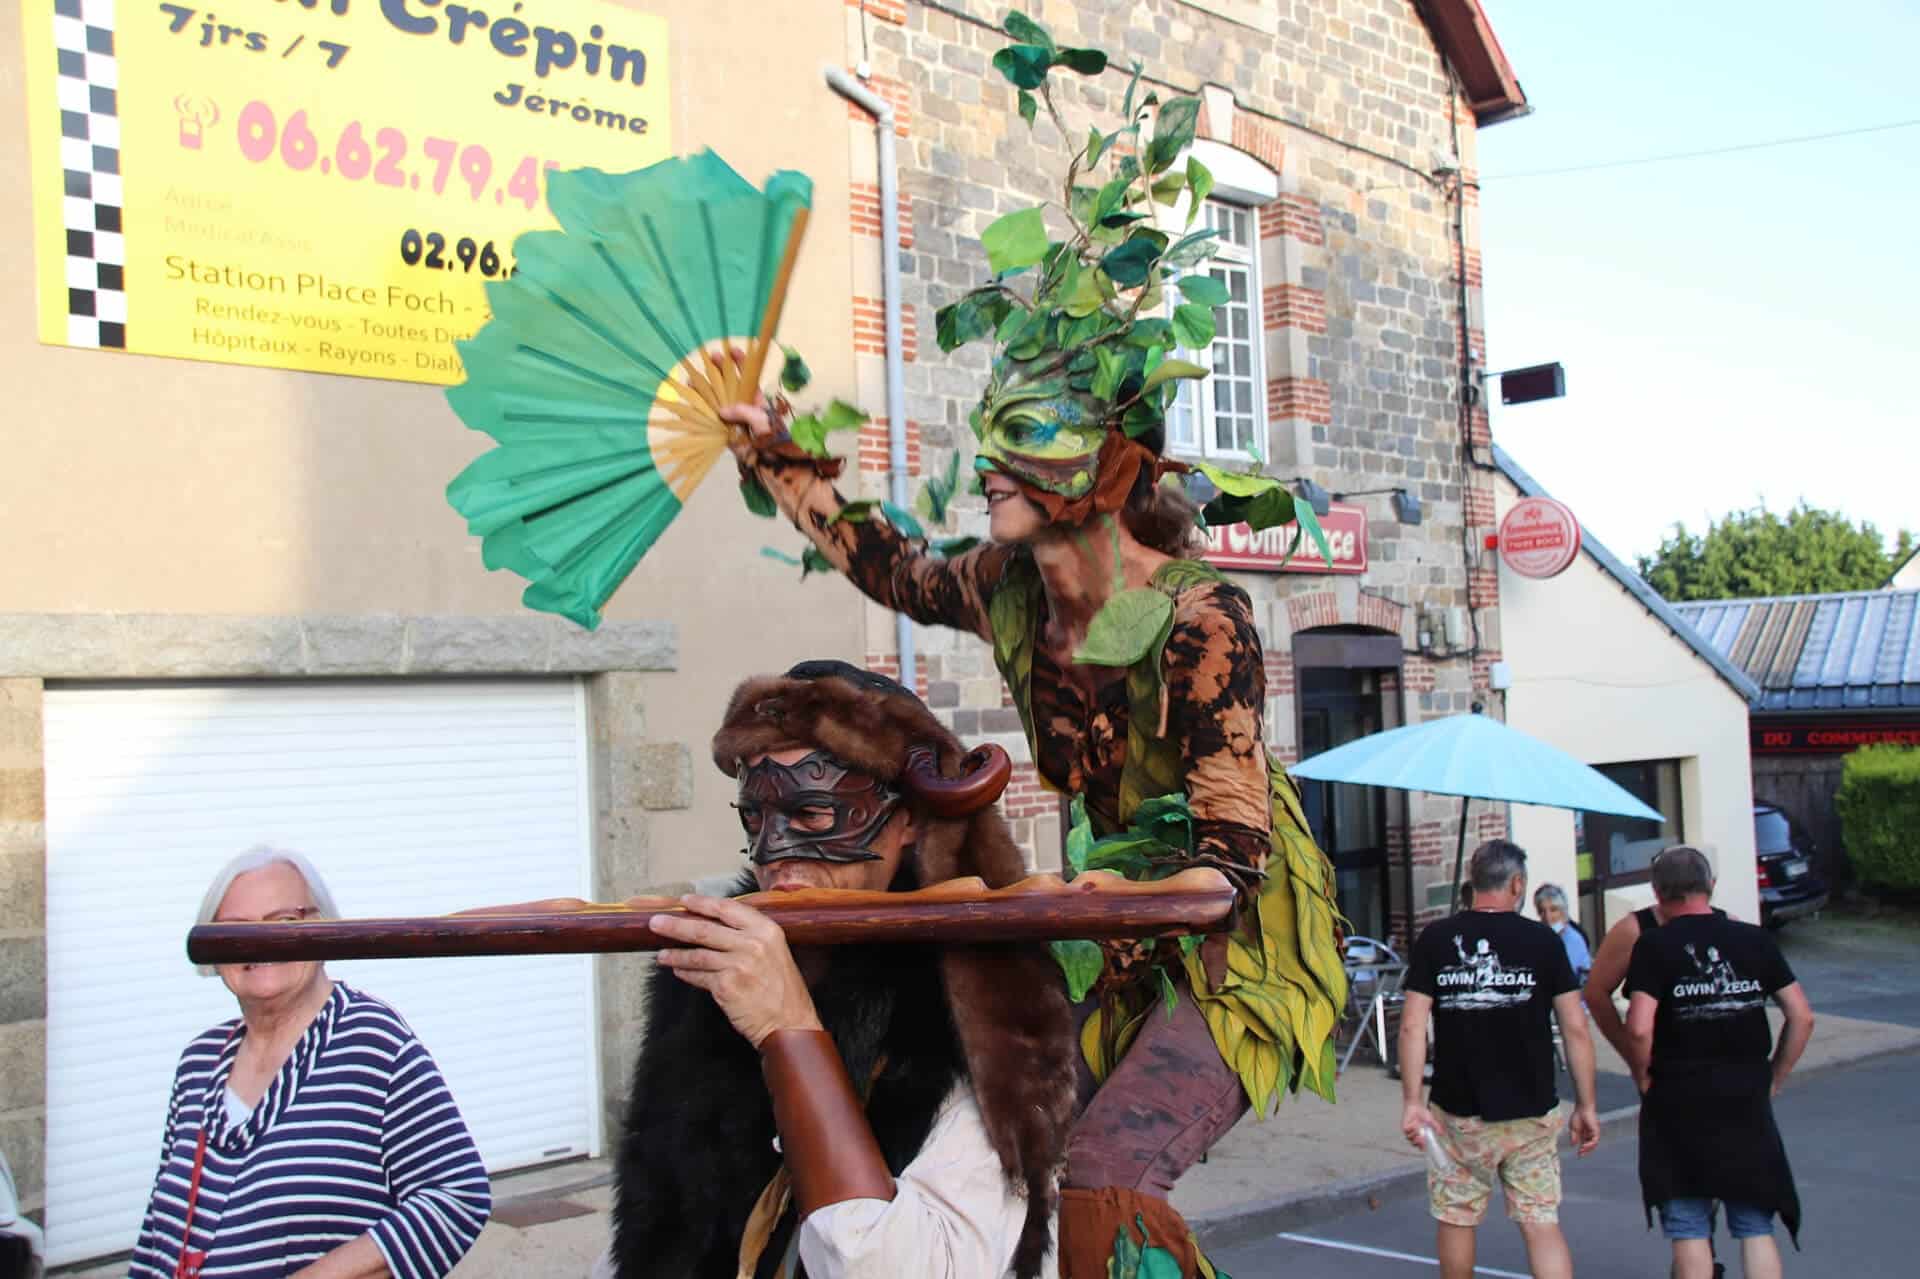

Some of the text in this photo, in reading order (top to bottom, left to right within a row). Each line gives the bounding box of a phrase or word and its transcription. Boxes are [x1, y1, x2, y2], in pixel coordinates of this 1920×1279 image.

[317, 40, 351, 68] 7
[379, 0, 647, 86] Crépin
[493, 83, 649, 134] Jérôme
[237, 99, 561, 211] 06.62.79.4
[401, 228, 519, 279] 02.96.
[165, 255, 286, 293] Station
[297, 273, 377, 305] Place
[387, 286, 455, 315] Foch
[196, 297, 342, 332] Rendez-vous
[360, 318, 429, 342] Toutes
[192, 327, 297, 354] Hôpitaux
[319, 341, 397, 366] Rayons
[1763, 732, 1792, 745] DU
[1437, 972, 1537, 986] GWIN ZEGAL
[1673, 982, 1715, 998] GWIN
